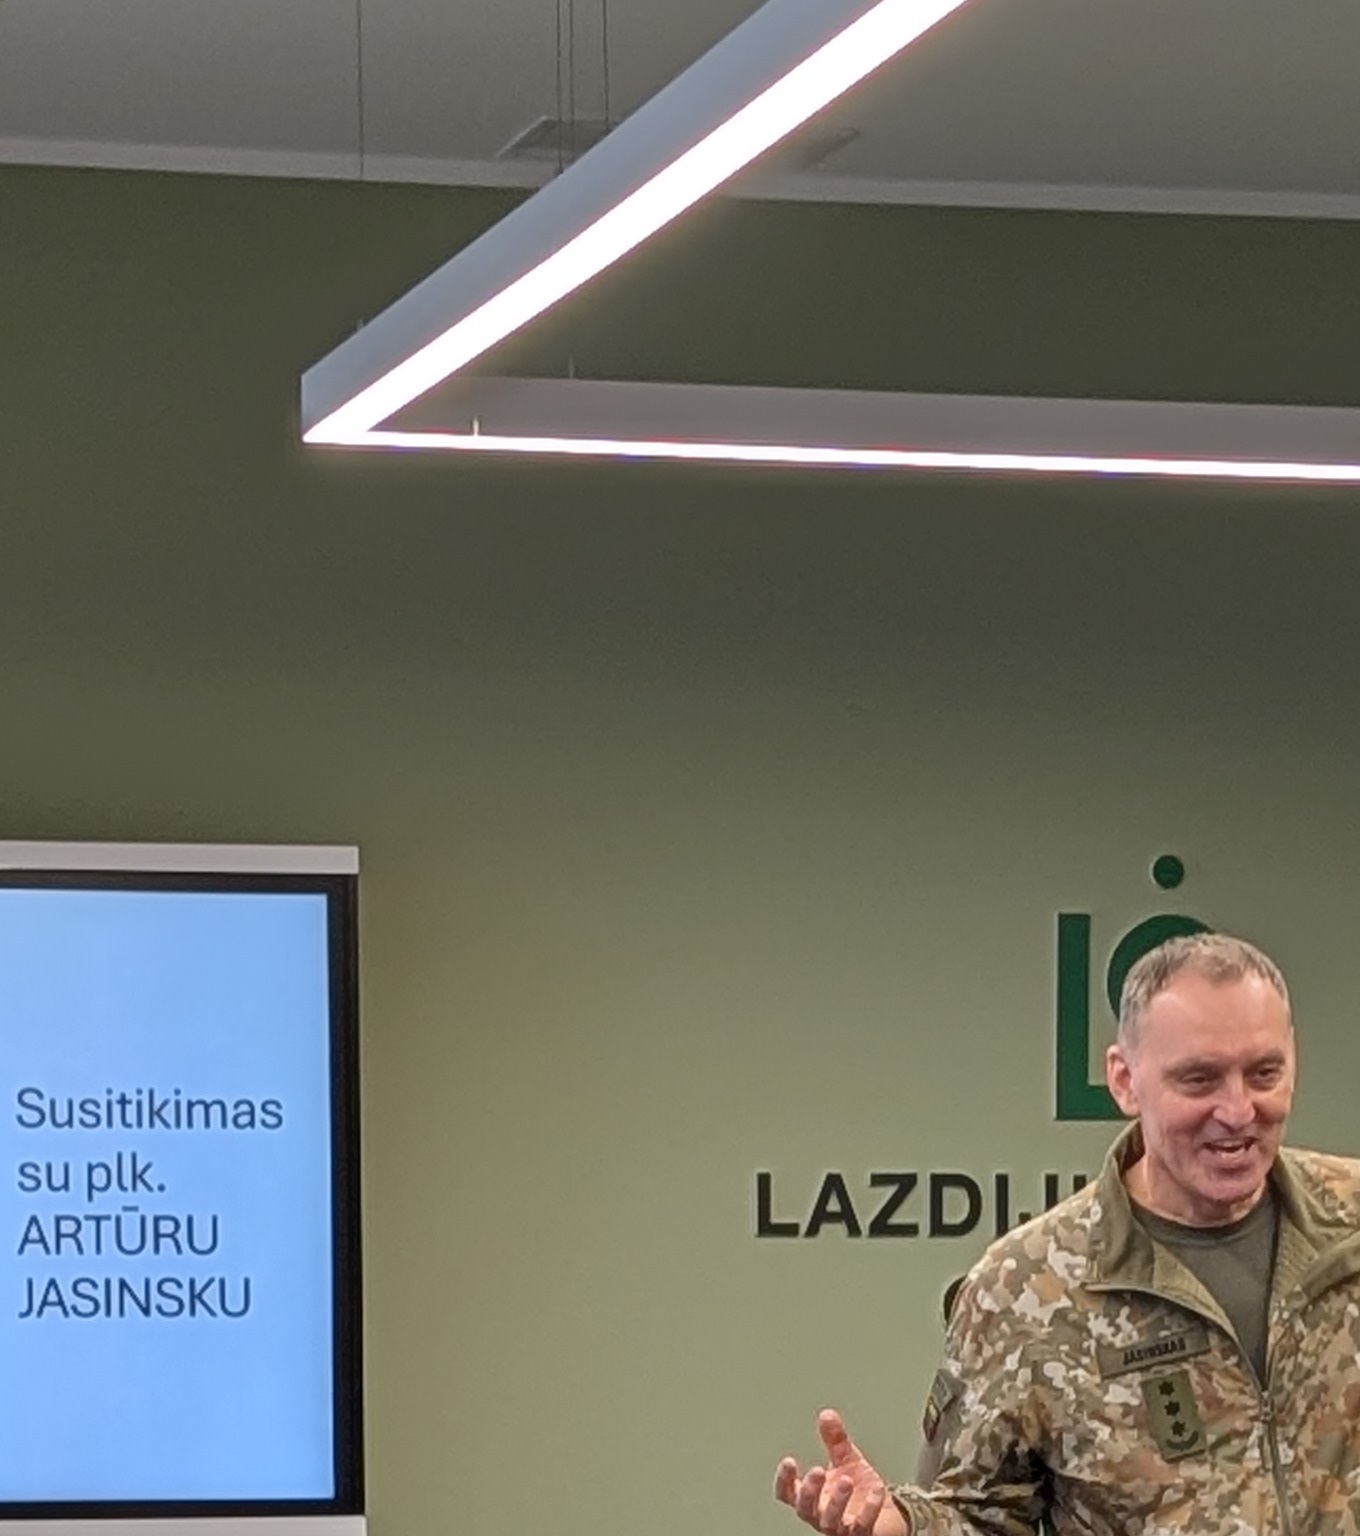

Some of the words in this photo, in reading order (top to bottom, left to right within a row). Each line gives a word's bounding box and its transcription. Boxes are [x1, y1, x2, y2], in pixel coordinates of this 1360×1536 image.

[15, 1086, 284, 1131] Susitikimas
[17, 1160, 71, 1193] su
[86, 1151, 167, 1203] plk.
[17, 1205, 219, 1256] ARTŪRU
[755, 1171, 1089, 1239] LAZDIJ
[17, 1276, 252, 1319] JASINSKU
